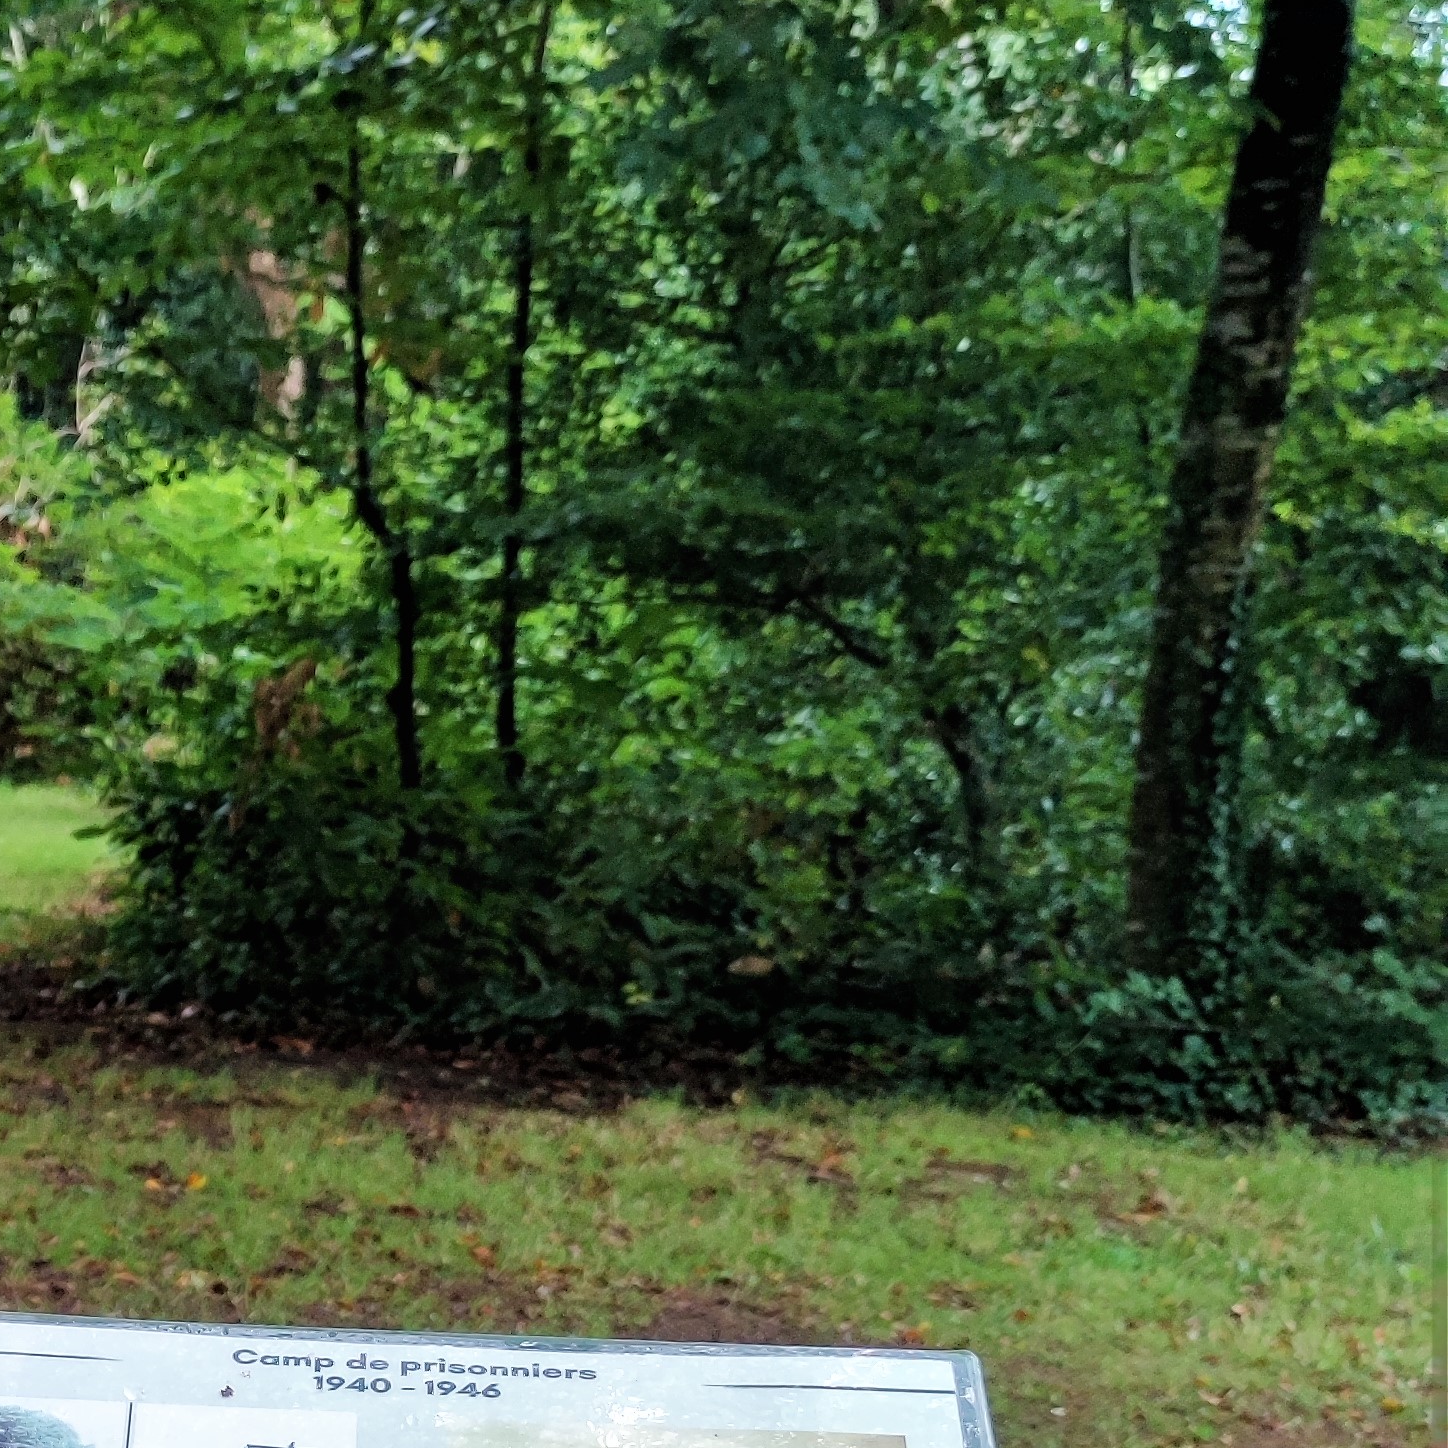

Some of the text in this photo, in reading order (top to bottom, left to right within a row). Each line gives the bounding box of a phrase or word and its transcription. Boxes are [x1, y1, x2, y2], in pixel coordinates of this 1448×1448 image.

[232, 1349, 597, 1381] Camp de prisonniers
[312, 1374, 392, 1393] 1940
[425, 1379, 502, 1398] 1946
